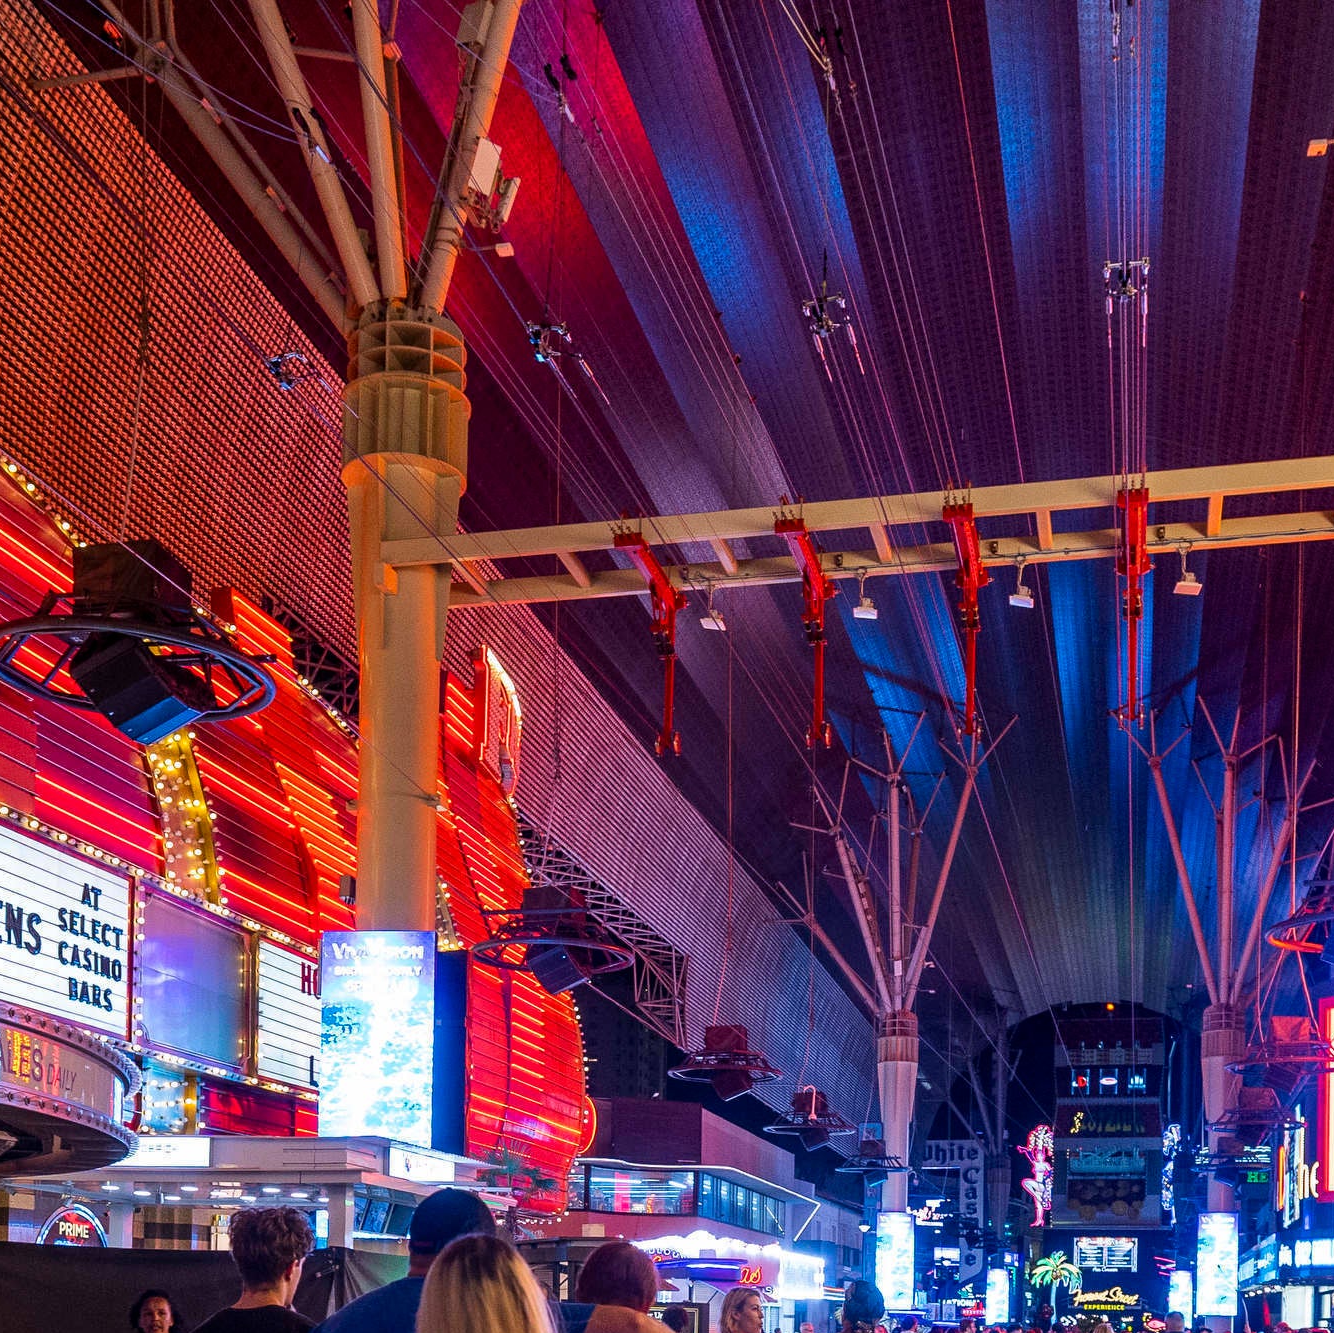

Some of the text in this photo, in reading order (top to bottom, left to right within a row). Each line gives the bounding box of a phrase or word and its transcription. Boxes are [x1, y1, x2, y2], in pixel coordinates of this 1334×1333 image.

[81, 882, 102, 911] AT
[57, 907, 123, 951] SELECT
[57, 940, 122, 983] CASINO
[68, 976, 113, 1013] BARS
[47, 1063, 78, 1092] DAILY
[59, 1221, 90, 1239] PRIME
[962, 1167, 980, 1267] Case
[1084, 1303, 1125, 1311] EXPERIENCE
